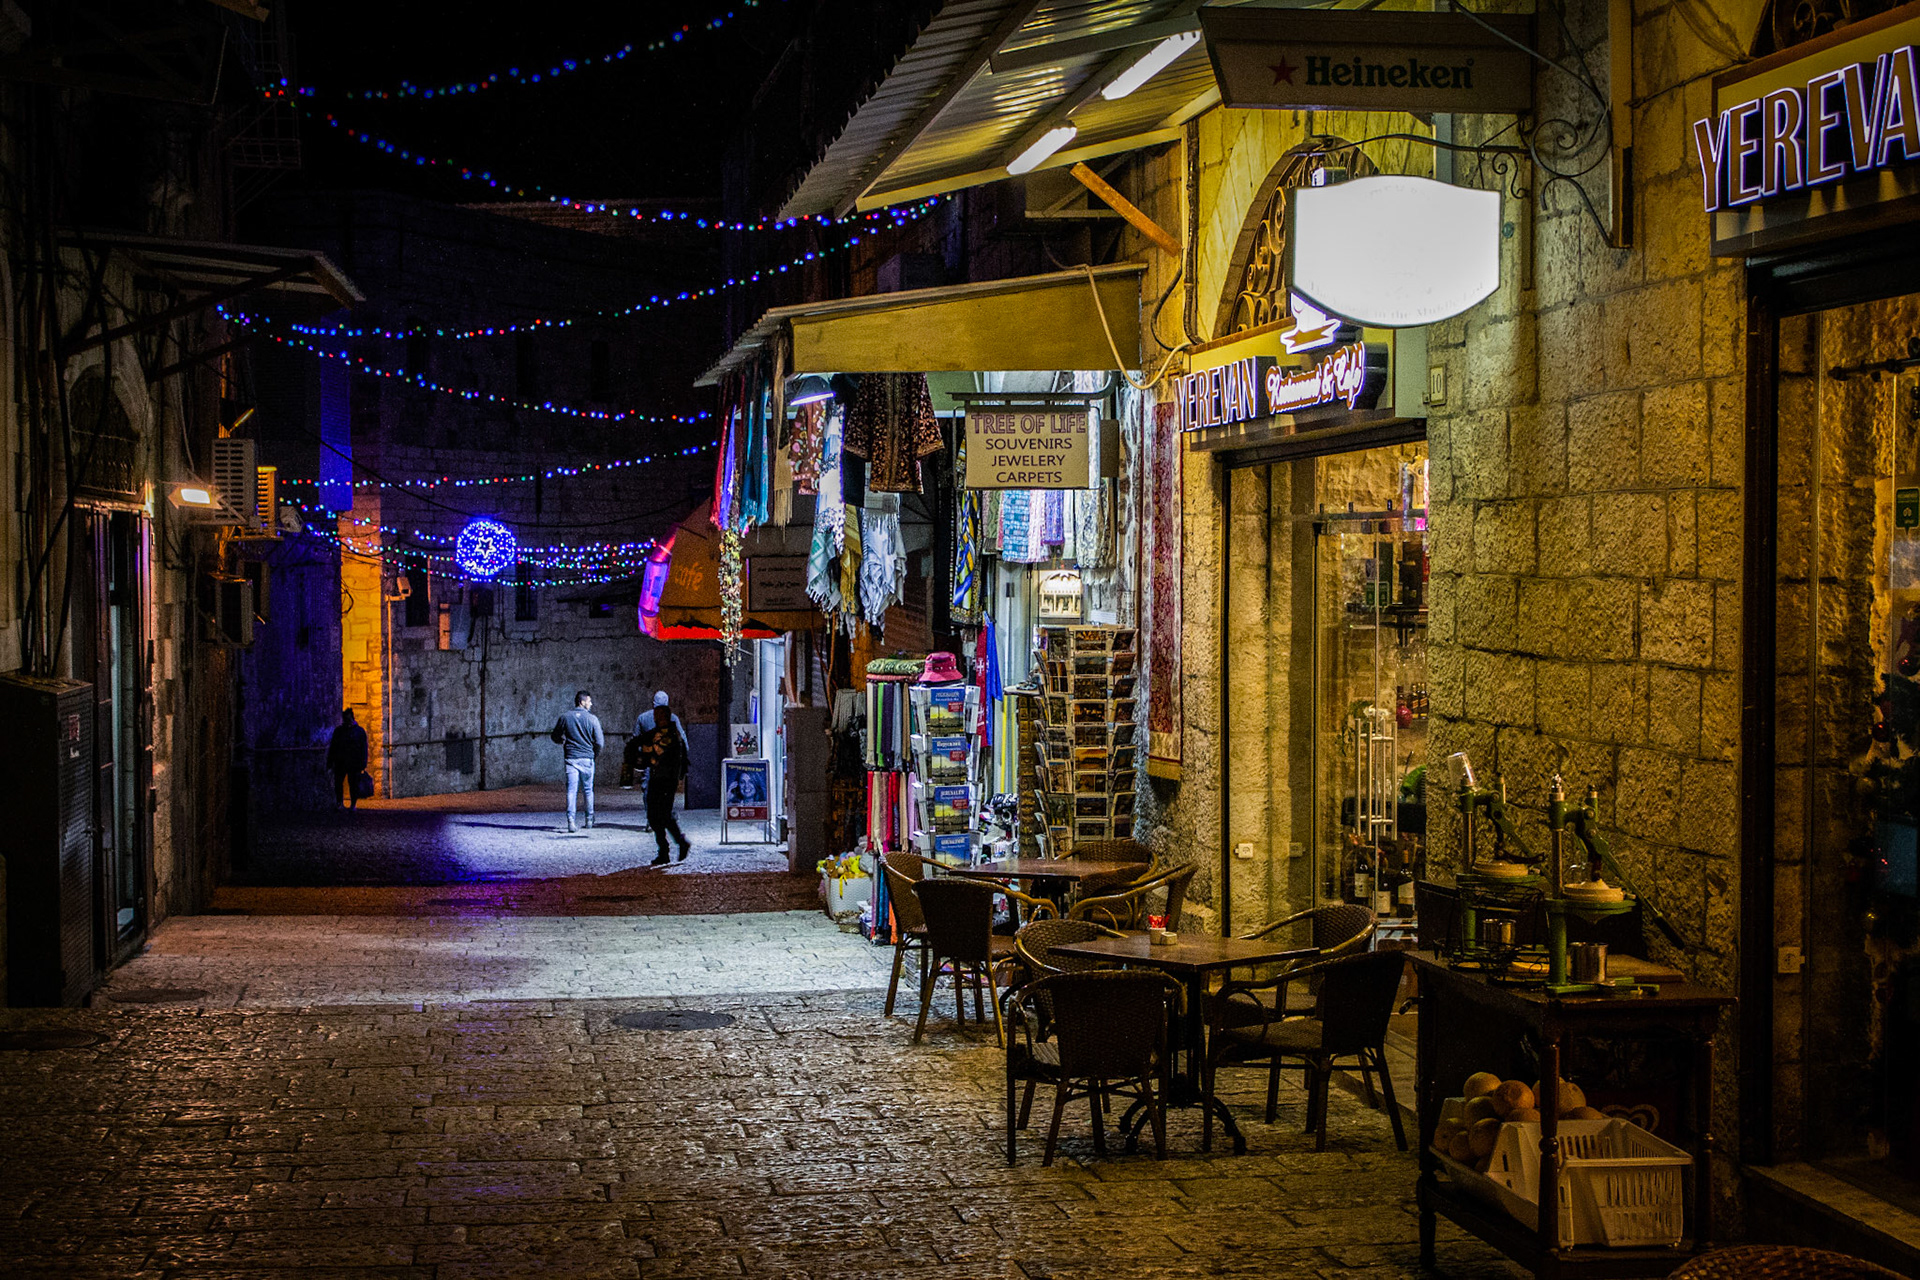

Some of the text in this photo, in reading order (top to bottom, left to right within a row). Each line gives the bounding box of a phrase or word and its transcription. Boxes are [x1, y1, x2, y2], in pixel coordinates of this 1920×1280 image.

[1305, 56, 1474, 89] Heineken
[1174, 356, 1257, 432] YEREVAN
[1433, 373, 1441, 394] 10
[971, 413, 1086, 434] TREE OF LIFE
[985, 438, 1072, 450] SOUVENIRS
[992, 455, 1066, 467] JEWELERY
[996, 471, 1062, 483] CARPETS
